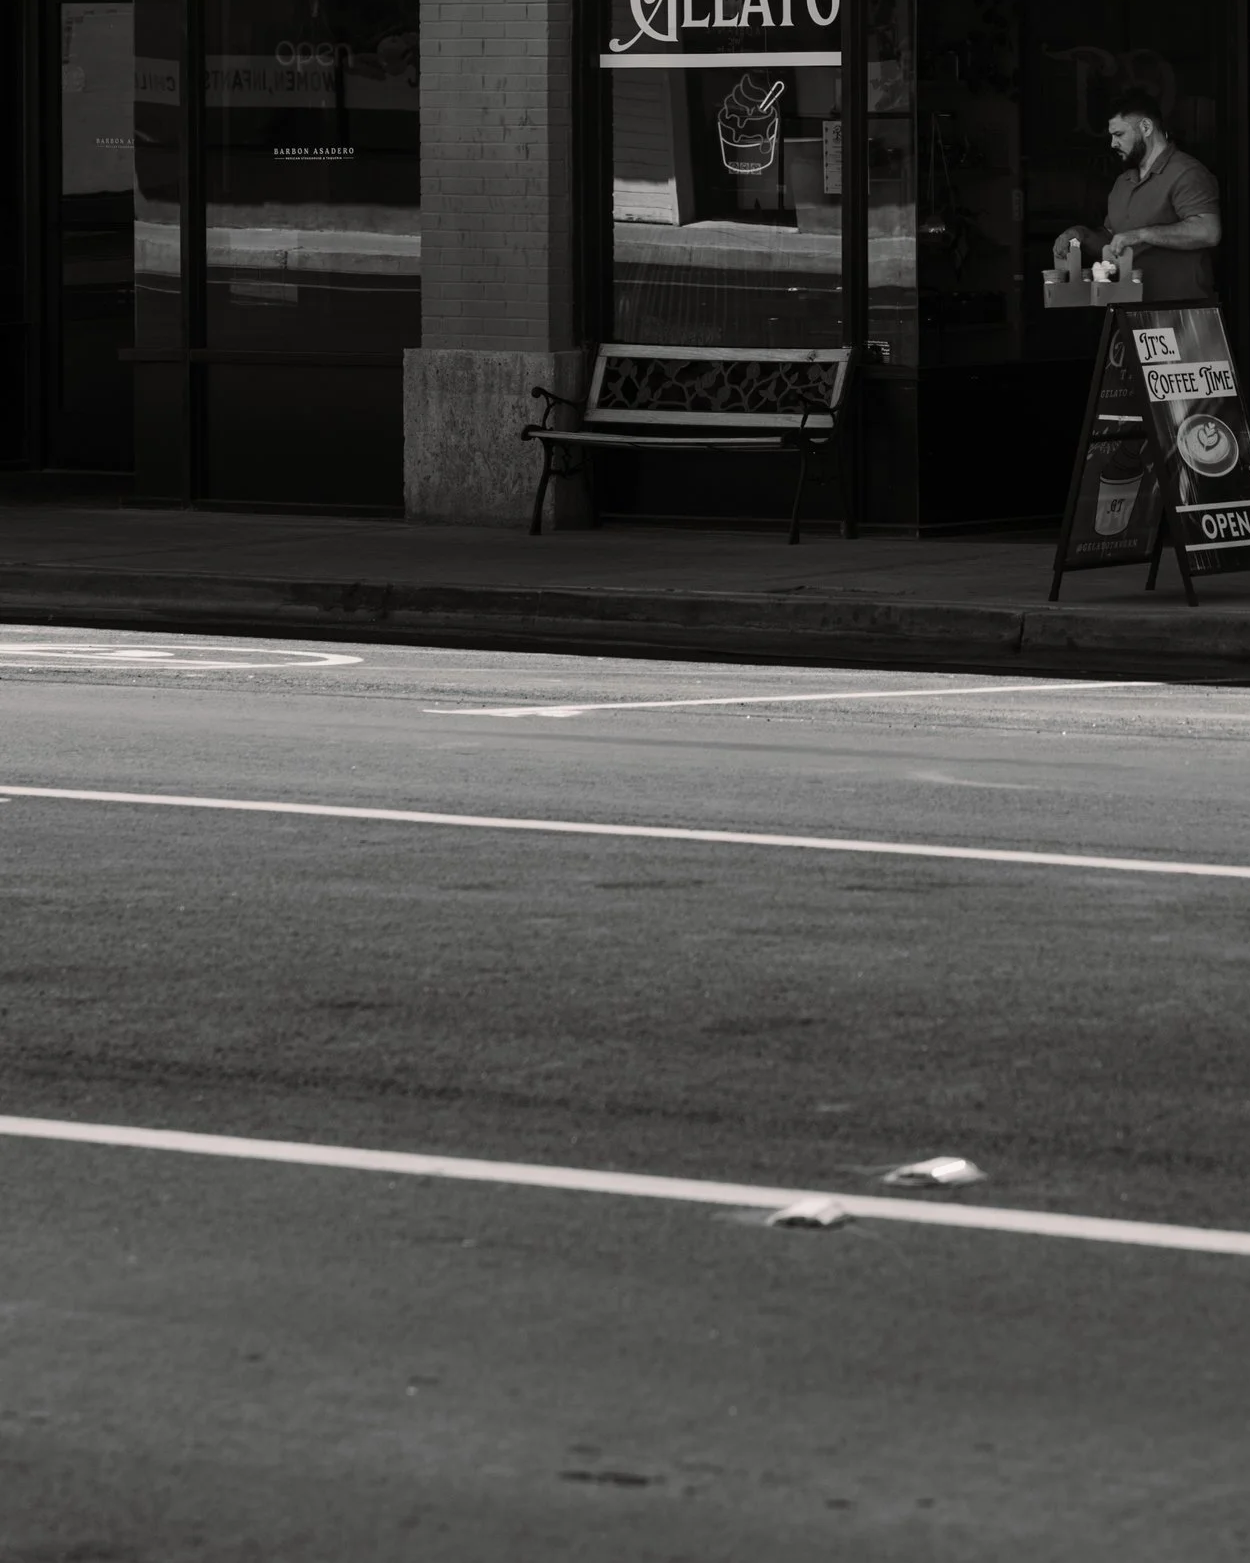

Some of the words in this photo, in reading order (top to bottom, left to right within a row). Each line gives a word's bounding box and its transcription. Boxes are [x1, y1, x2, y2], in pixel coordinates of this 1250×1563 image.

[274, 40, 354, 73] open
[273, 147, 309, 155] BARBON
[313, 147, 354, 155] ASADERO
[1148, 370, 1199, 400] COFFEE
[1199, 365, 1233, 396] TIME
[1100, 389, 1128, 399] GELATO
